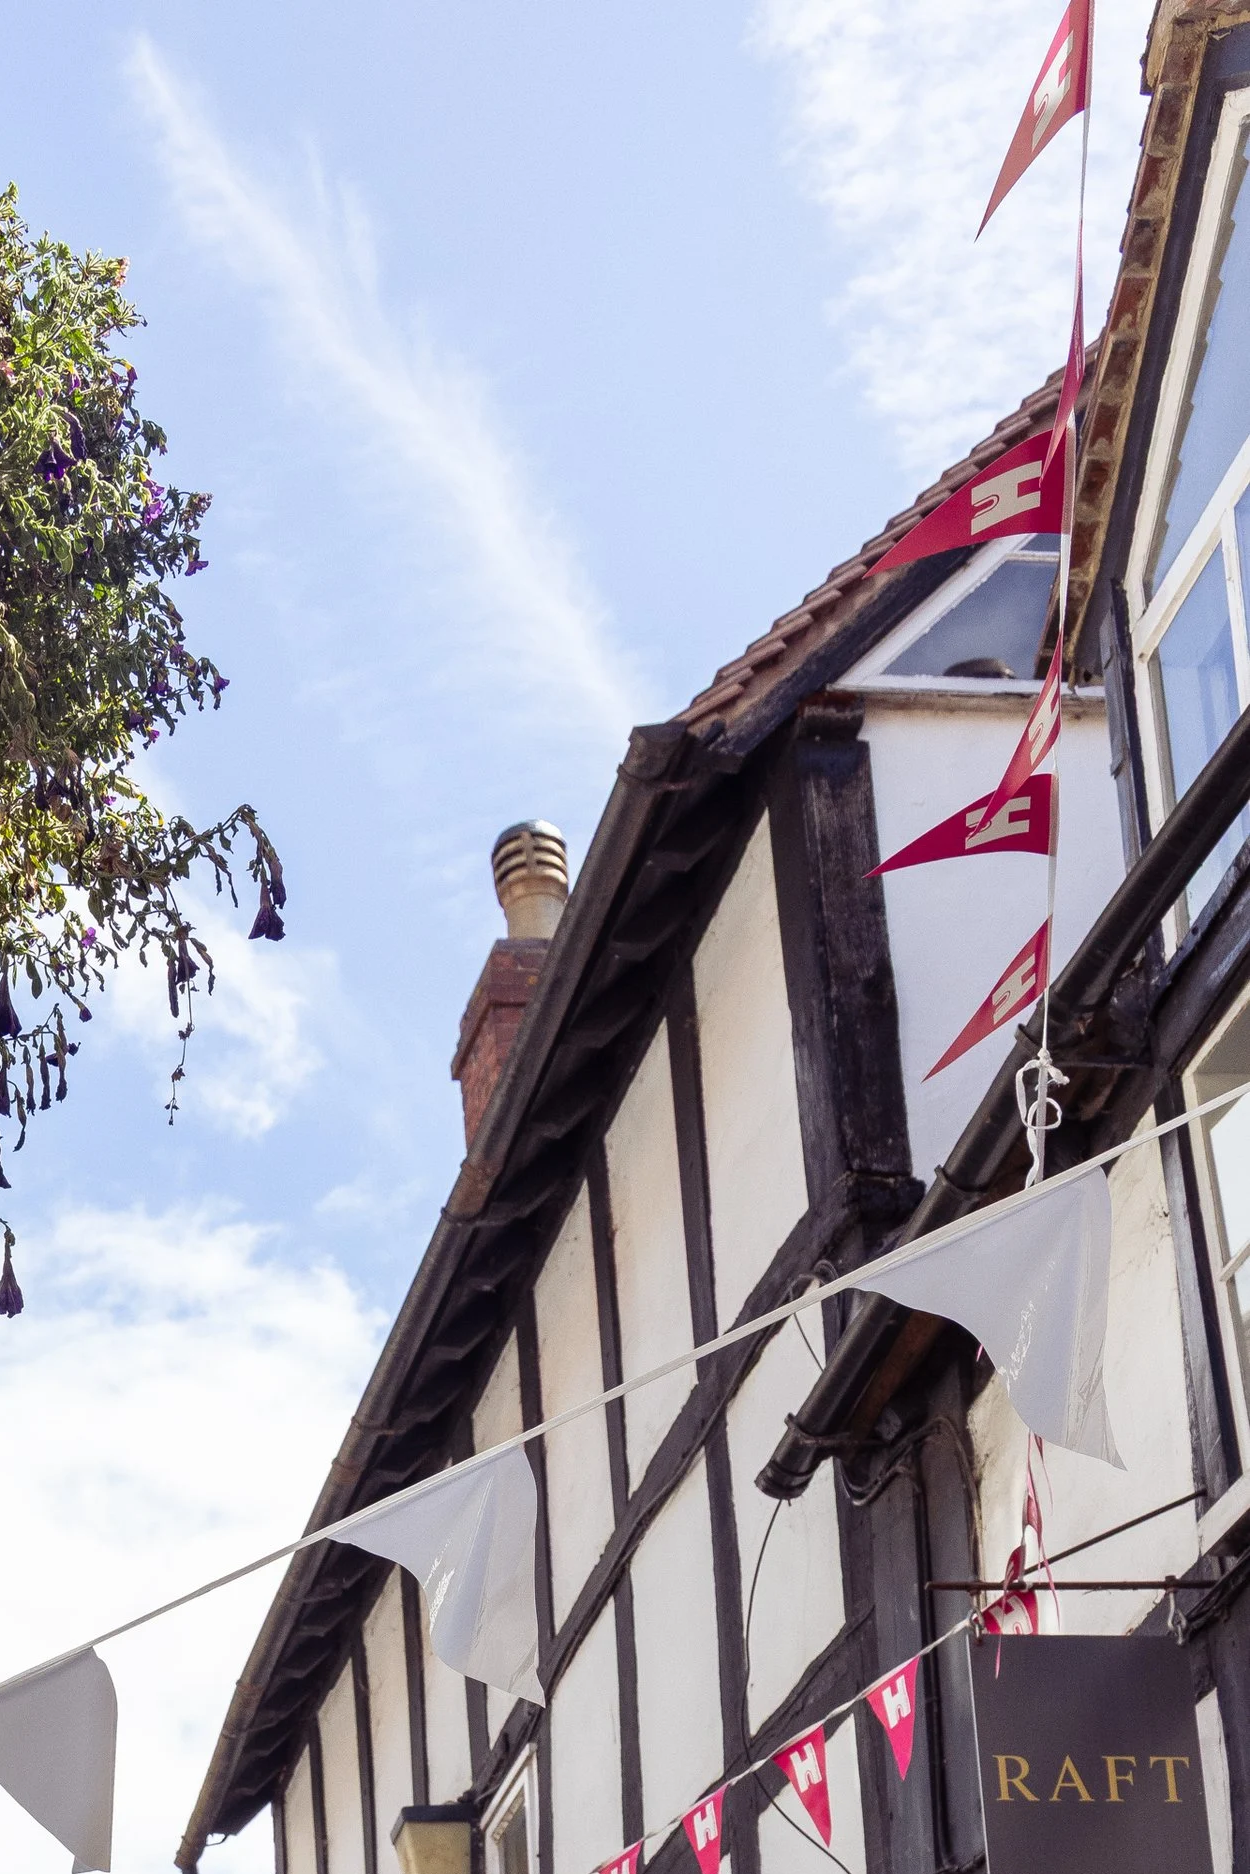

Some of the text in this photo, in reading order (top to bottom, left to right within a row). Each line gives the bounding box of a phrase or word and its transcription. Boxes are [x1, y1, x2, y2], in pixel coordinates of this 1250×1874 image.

[1032, 32, 1073, 151] H
[971, 461, 1042, 535] H
[1029, 670, 1059, 770] H
[965, 797, 1030, 849] H
[993, 954, 1035, 1025] H
[882, 1674, 911, 1729] H
[789, 1742, 822, 1793] H
[992, 1754, 1190, 1803] RAFT
[693, 1801, 718, 1851] H
